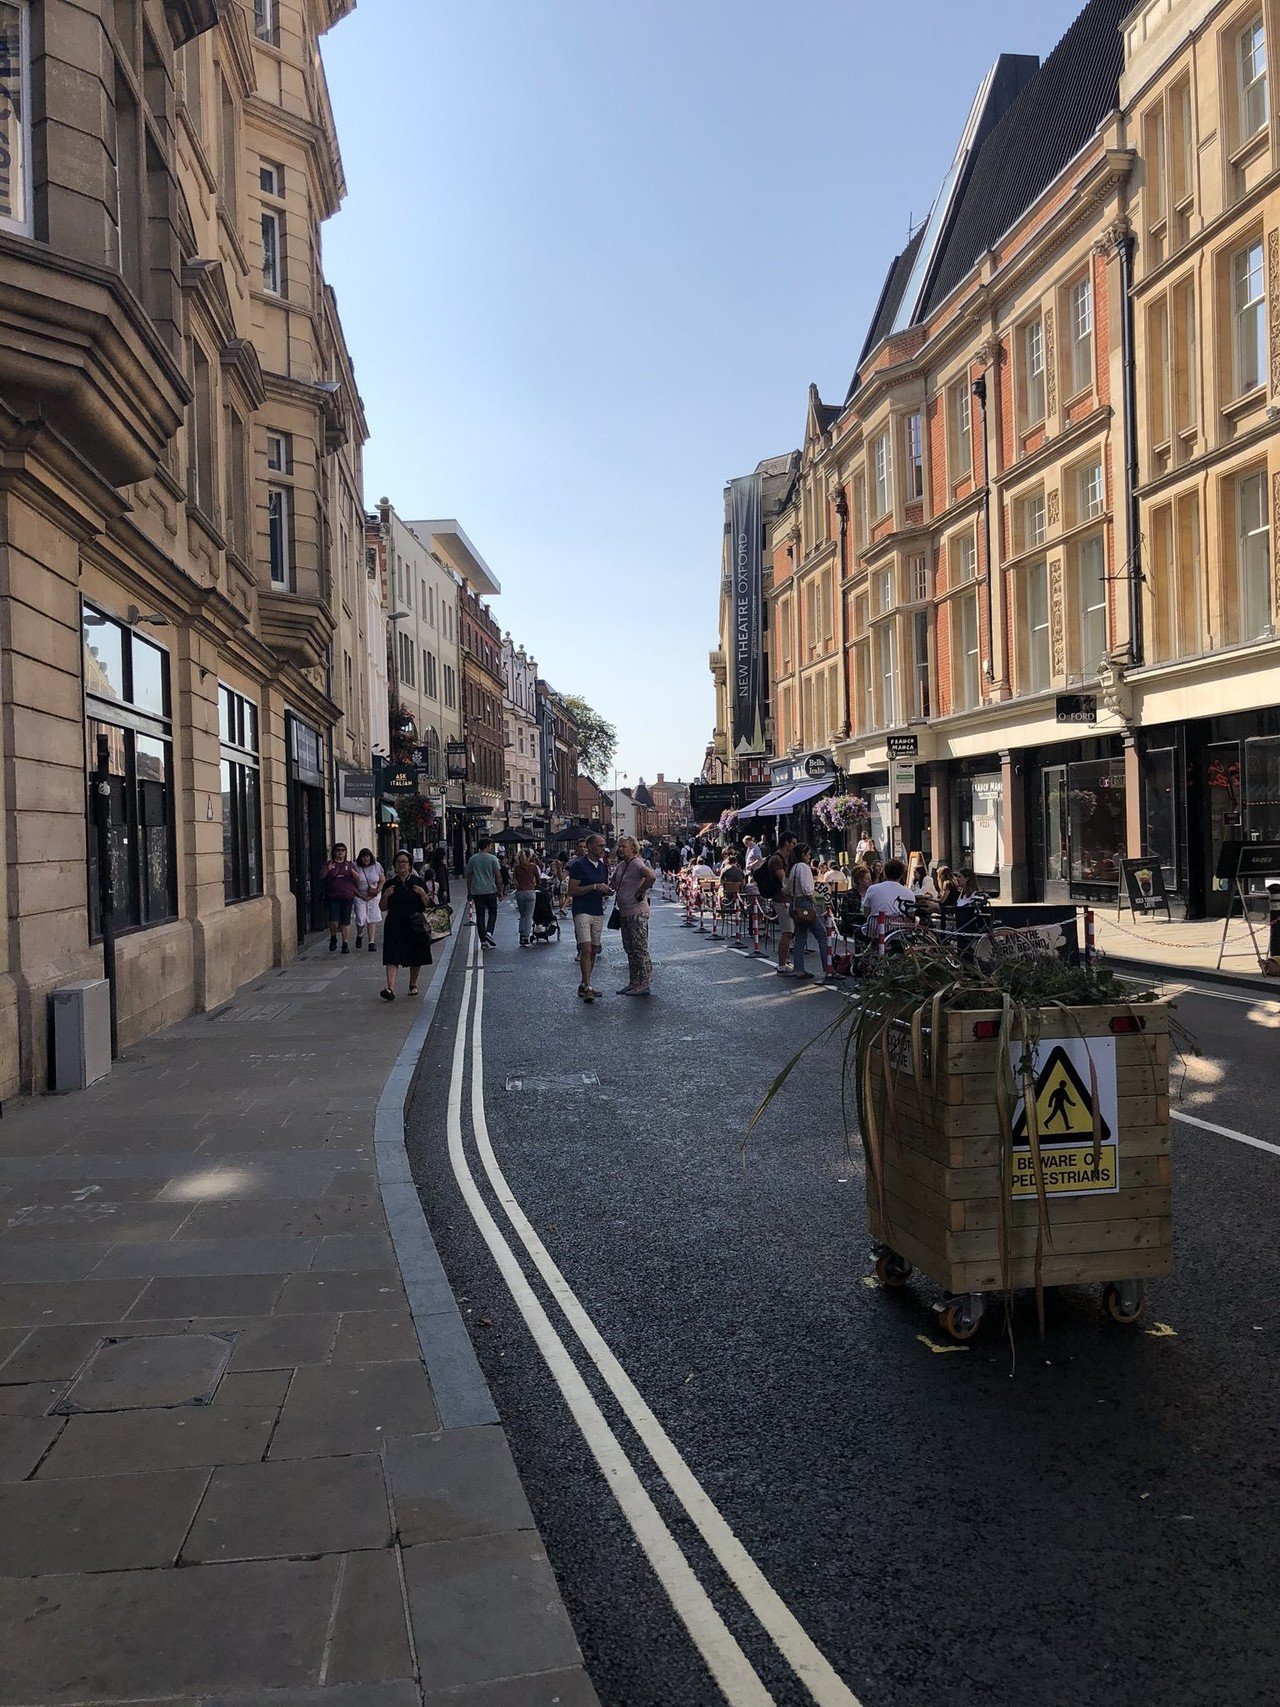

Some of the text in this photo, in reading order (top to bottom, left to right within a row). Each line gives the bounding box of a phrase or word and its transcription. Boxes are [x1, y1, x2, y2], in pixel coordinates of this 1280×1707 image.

[738, 533, 748, 696] NEW THEATRE OXFORD
[1058, 712, 1095, 721] OFORD
[809, 759, 825, 767] Bella
[809, 767, 826, 775] Italia
[1017, 1153, 1077, 1170] BEWARE
[1011, 1168, 1110, 1187] PEDESTRIANS
